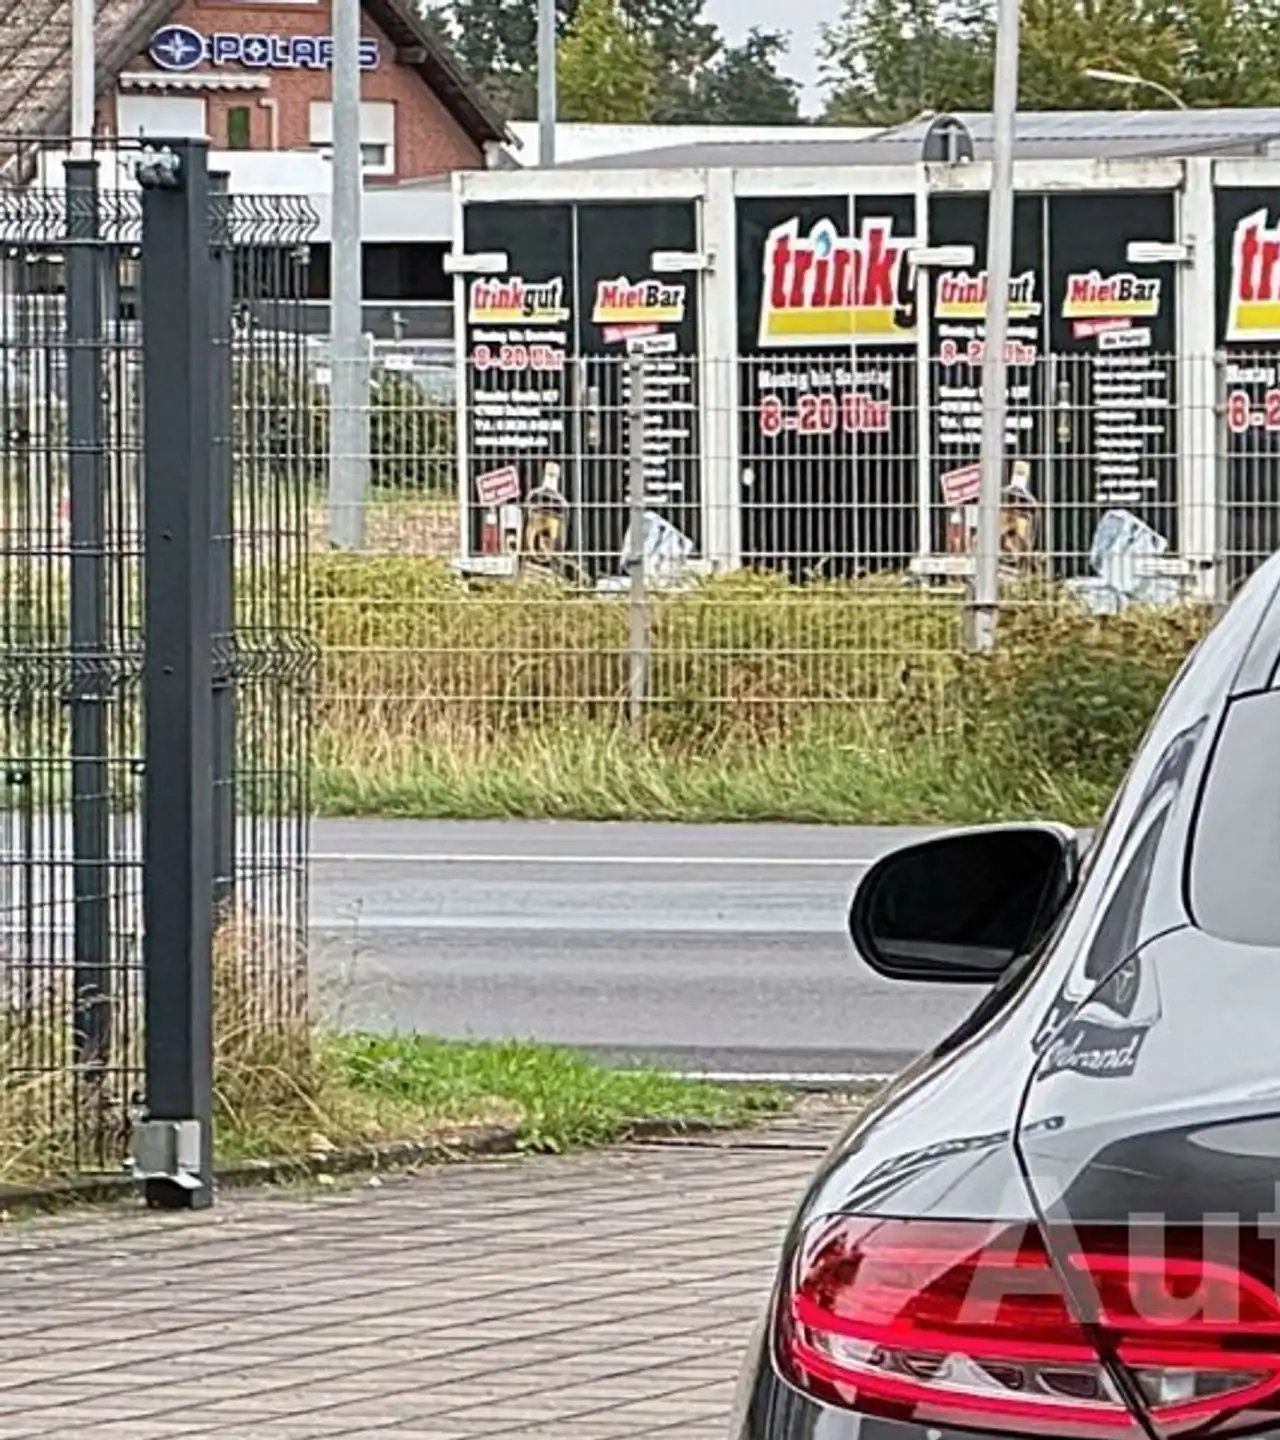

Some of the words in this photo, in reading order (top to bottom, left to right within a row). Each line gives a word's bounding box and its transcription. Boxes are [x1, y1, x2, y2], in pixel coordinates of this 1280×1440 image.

[771, 226, 917, 329] trinkg
[1072, 276, 1158, 304] MietBar
[474, 280, 560, 317] trinkgut
[600, 281, 682, 309] MietBar
